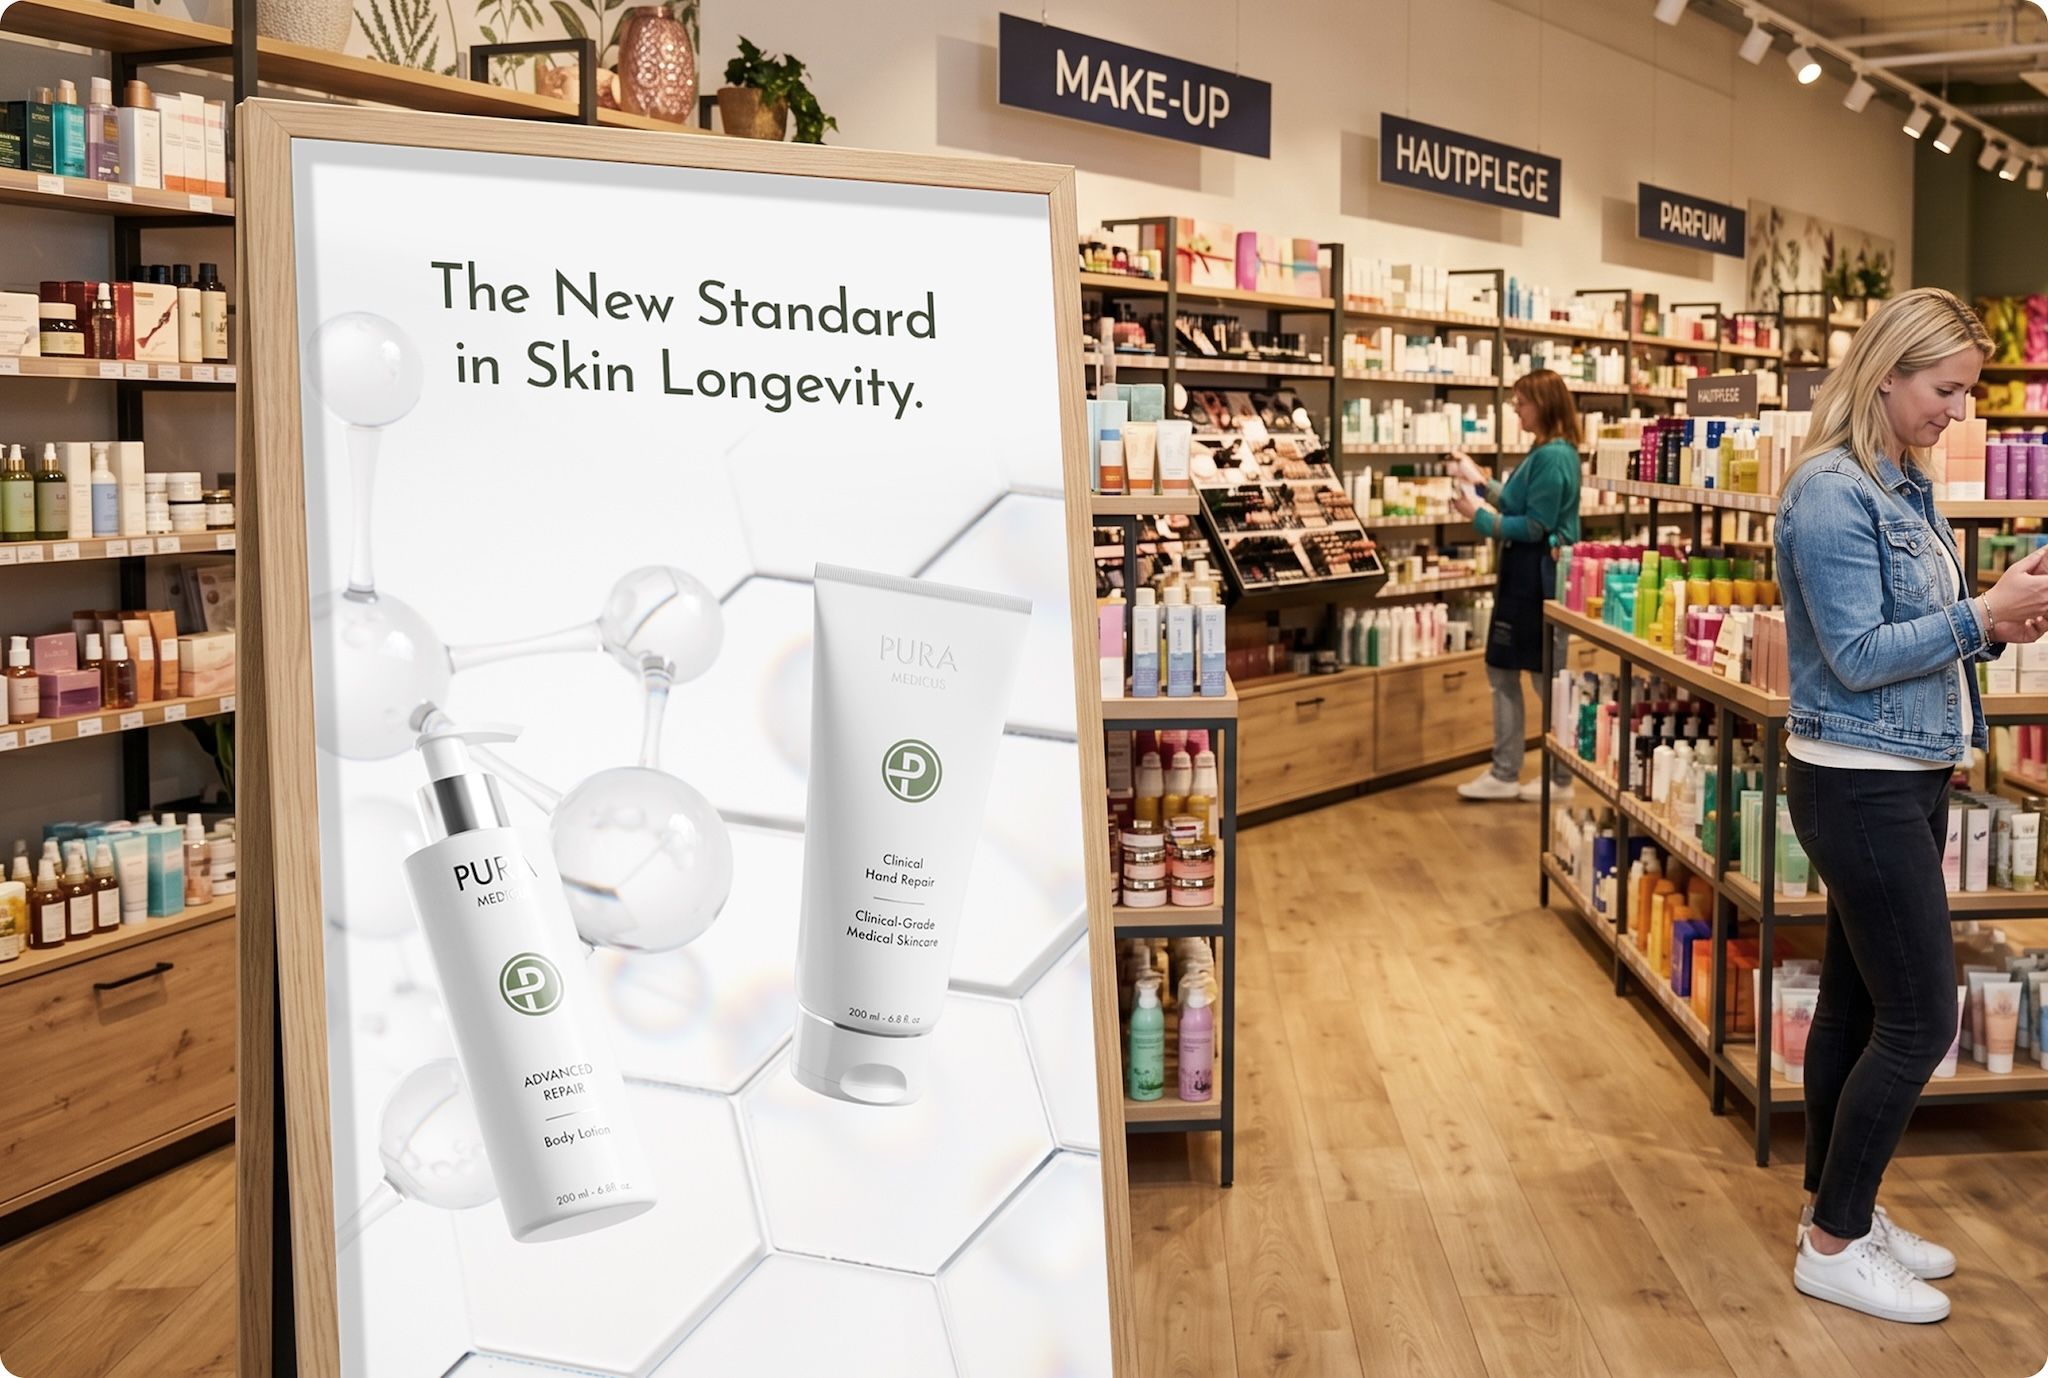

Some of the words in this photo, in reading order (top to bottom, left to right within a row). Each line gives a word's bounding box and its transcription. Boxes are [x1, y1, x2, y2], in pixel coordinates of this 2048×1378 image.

[1055, 48, 1231, 131] MAKE-UP
[1395, 132, 1550, 204] HAUTPFLEGE
[1659, 200, 1727, 245] PARFUM
[430, 260, 530, 313] The
[555, 268, 675, 323] New
[698, 279, 937, 340] Standard
[456, 341, 500, 385] in
[526, 339, 635, 393] Skin
[661, 347, 924, 421] Longevity.
[1697, 386, 1741, 405] HAUTPFLEGE
[880, 634, 959, 672] PURA
[890, 672, 947, 690] MEDICUS
[882, 853, 924, 869] Clinical
[865, 867, 898, 884] Hand
[900, 873, 936, 889] Repair
[855, 909, 936, 931] Clinical-Grade
[846, 926, 894, 945] Medical
[896, 932, 939, 948] Skincare
[848, 1007, 867, 1019] 200
[869, 1012, 881, 1021] ml
[524, 1063, 594, 1088] ADVANCED
[543, 1082, 587, 1101] REPAIR
[544, 1131, 575, 1148] Body
[577, 1124, 611, 1140] Lotion
[556, 1192, 576, 1206] 200
[577, 1189, 590, 1200] ml
